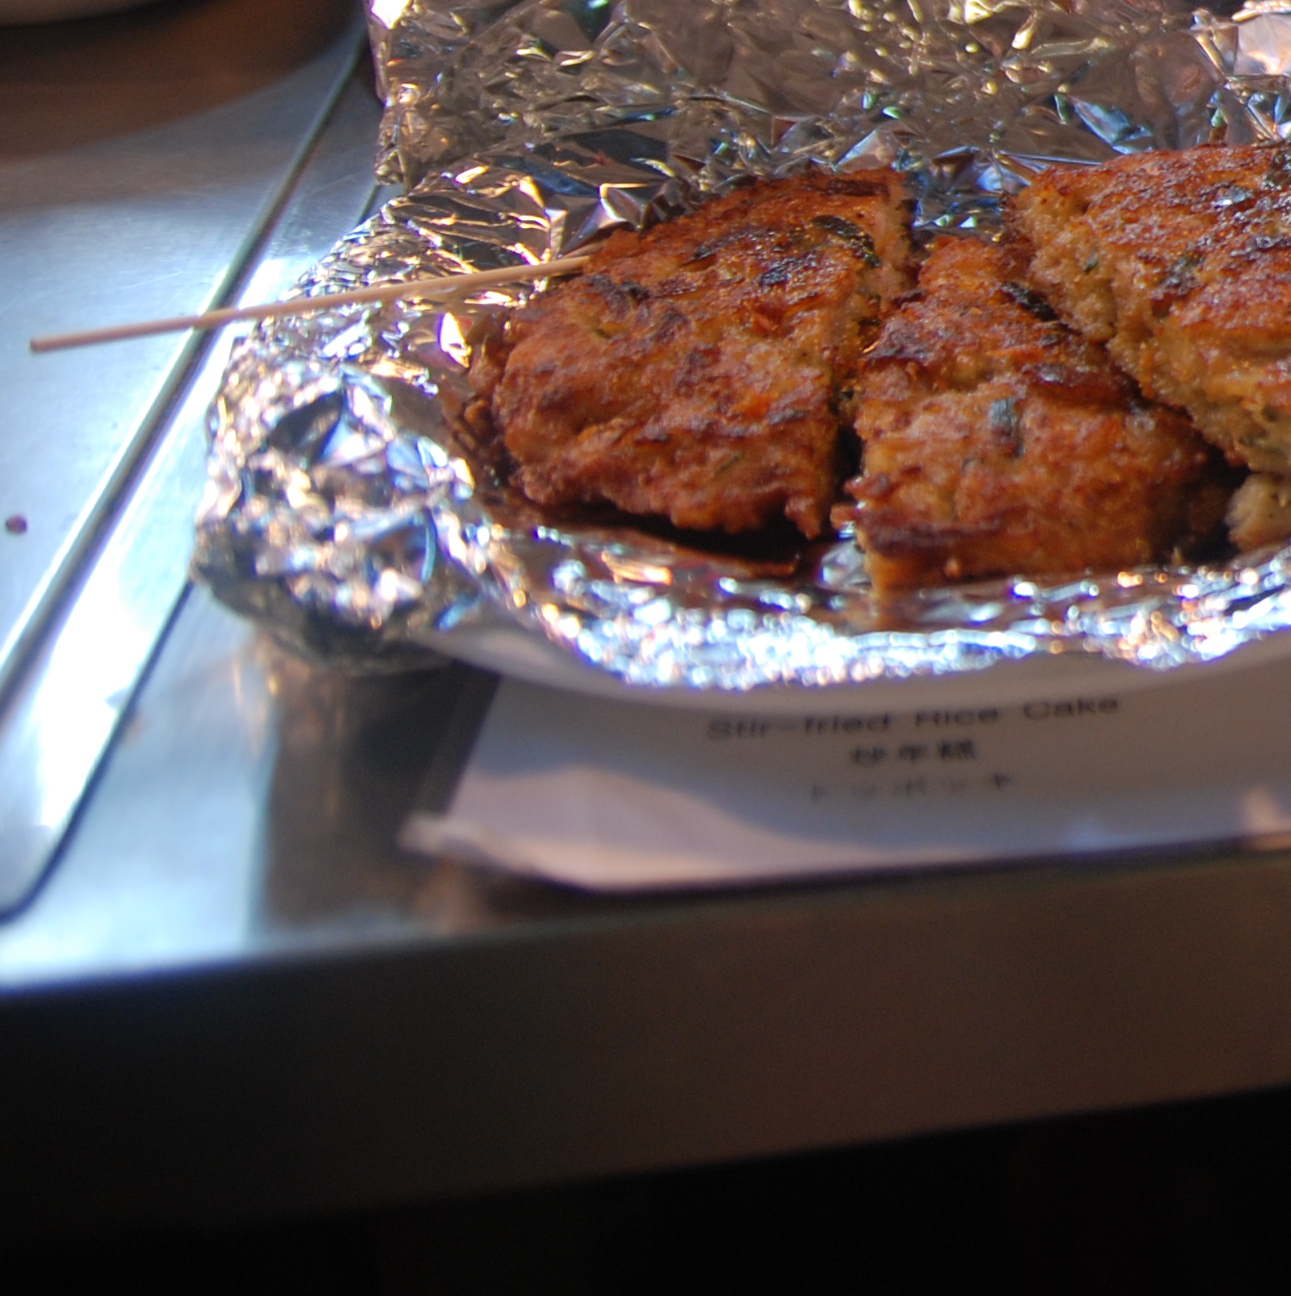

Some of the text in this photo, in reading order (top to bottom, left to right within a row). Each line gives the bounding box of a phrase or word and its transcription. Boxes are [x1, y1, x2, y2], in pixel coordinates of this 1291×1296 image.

[707, 697, 1118, 741] Stir-fried Rice Cake
